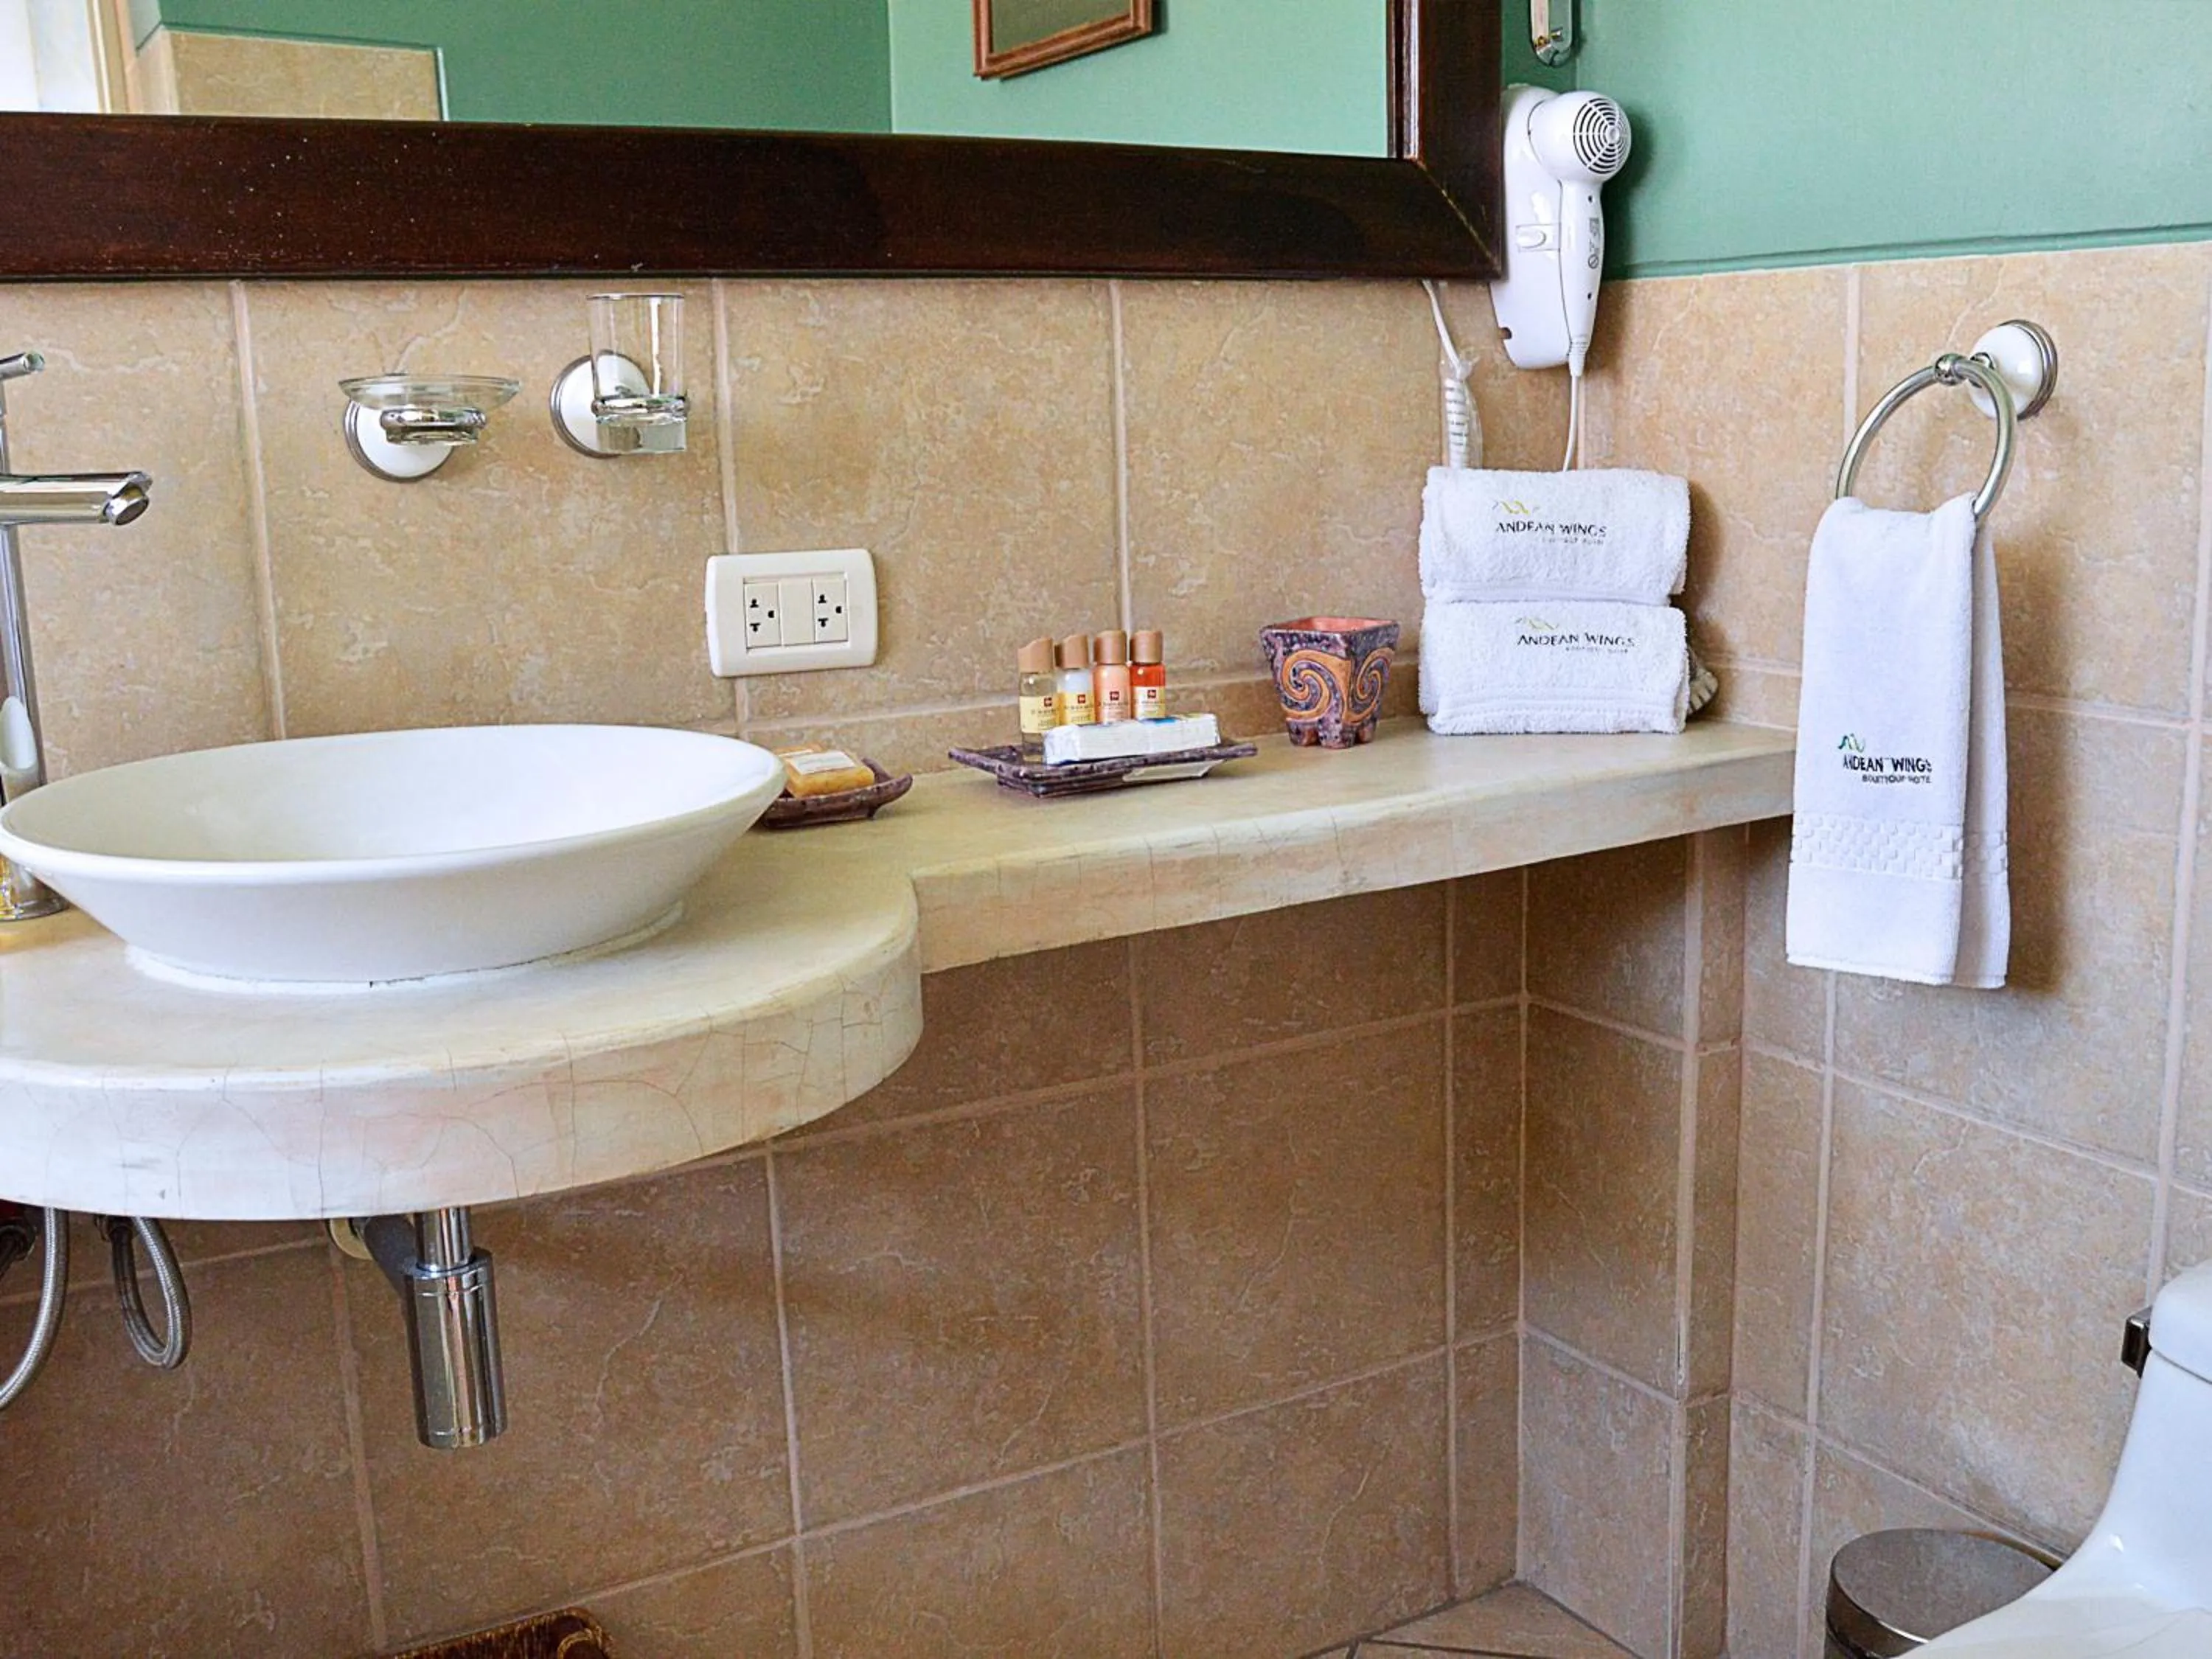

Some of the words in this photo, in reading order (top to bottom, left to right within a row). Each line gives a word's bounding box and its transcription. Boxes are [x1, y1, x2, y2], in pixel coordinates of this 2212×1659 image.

[1496, 520, 1555, 535] ANDEAN
[1559, 522, 1607, 538] WINGS
[1517, 634, 1579, 646] ANDEAN
[1585, 632, 1635, 647] WINGS
[1843, 754, 1883, 773] ANDEAN
[1891, 757, 1933, 773] WINGS
